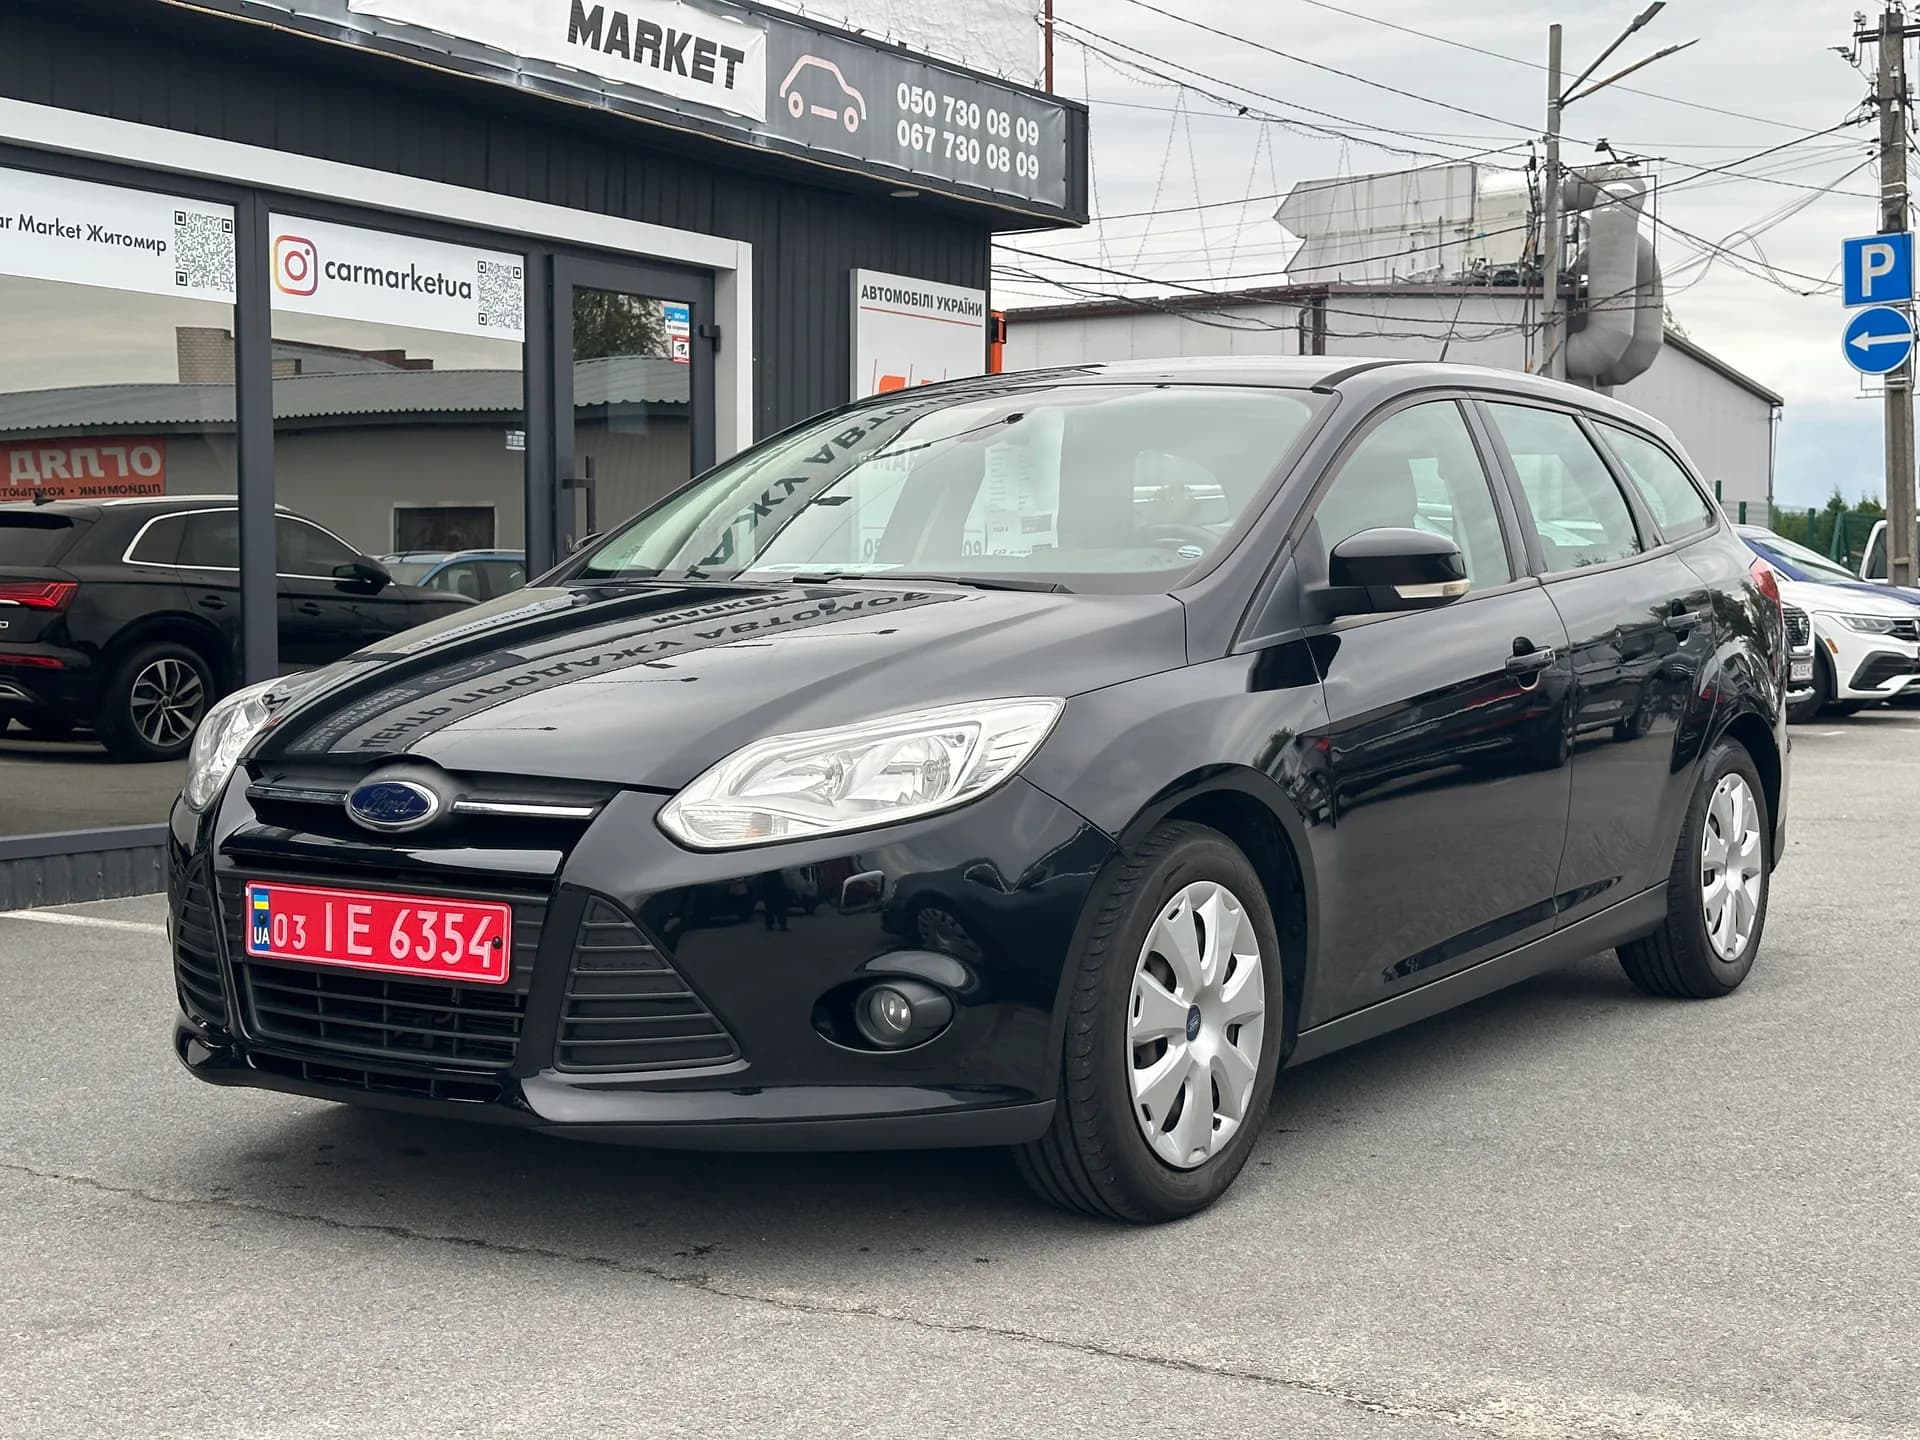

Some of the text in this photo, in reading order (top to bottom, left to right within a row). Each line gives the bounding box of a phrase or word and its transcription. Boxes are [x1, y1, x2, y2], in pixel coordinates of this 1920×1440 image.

[568, 0, 744, 89] MARKET
[897, 82, 1039, 146] 050 730 08 09
[897, 119, 1039, 179] 067 730 08 09
[18, 213, 82, 240] Market
[86, 223, 167, 256] Житомир
[325, 260, 472, 299] carmarketua
[1861, 243, 1895, 297] P
[861, 284, 983, 317] АВТОМОБІЛІ УКРАЇНИ
[362, 786, 416, 817] Ford
[254, 926, 270, 945] UA
[273, 902, 492, 969] 03 IE 6354
